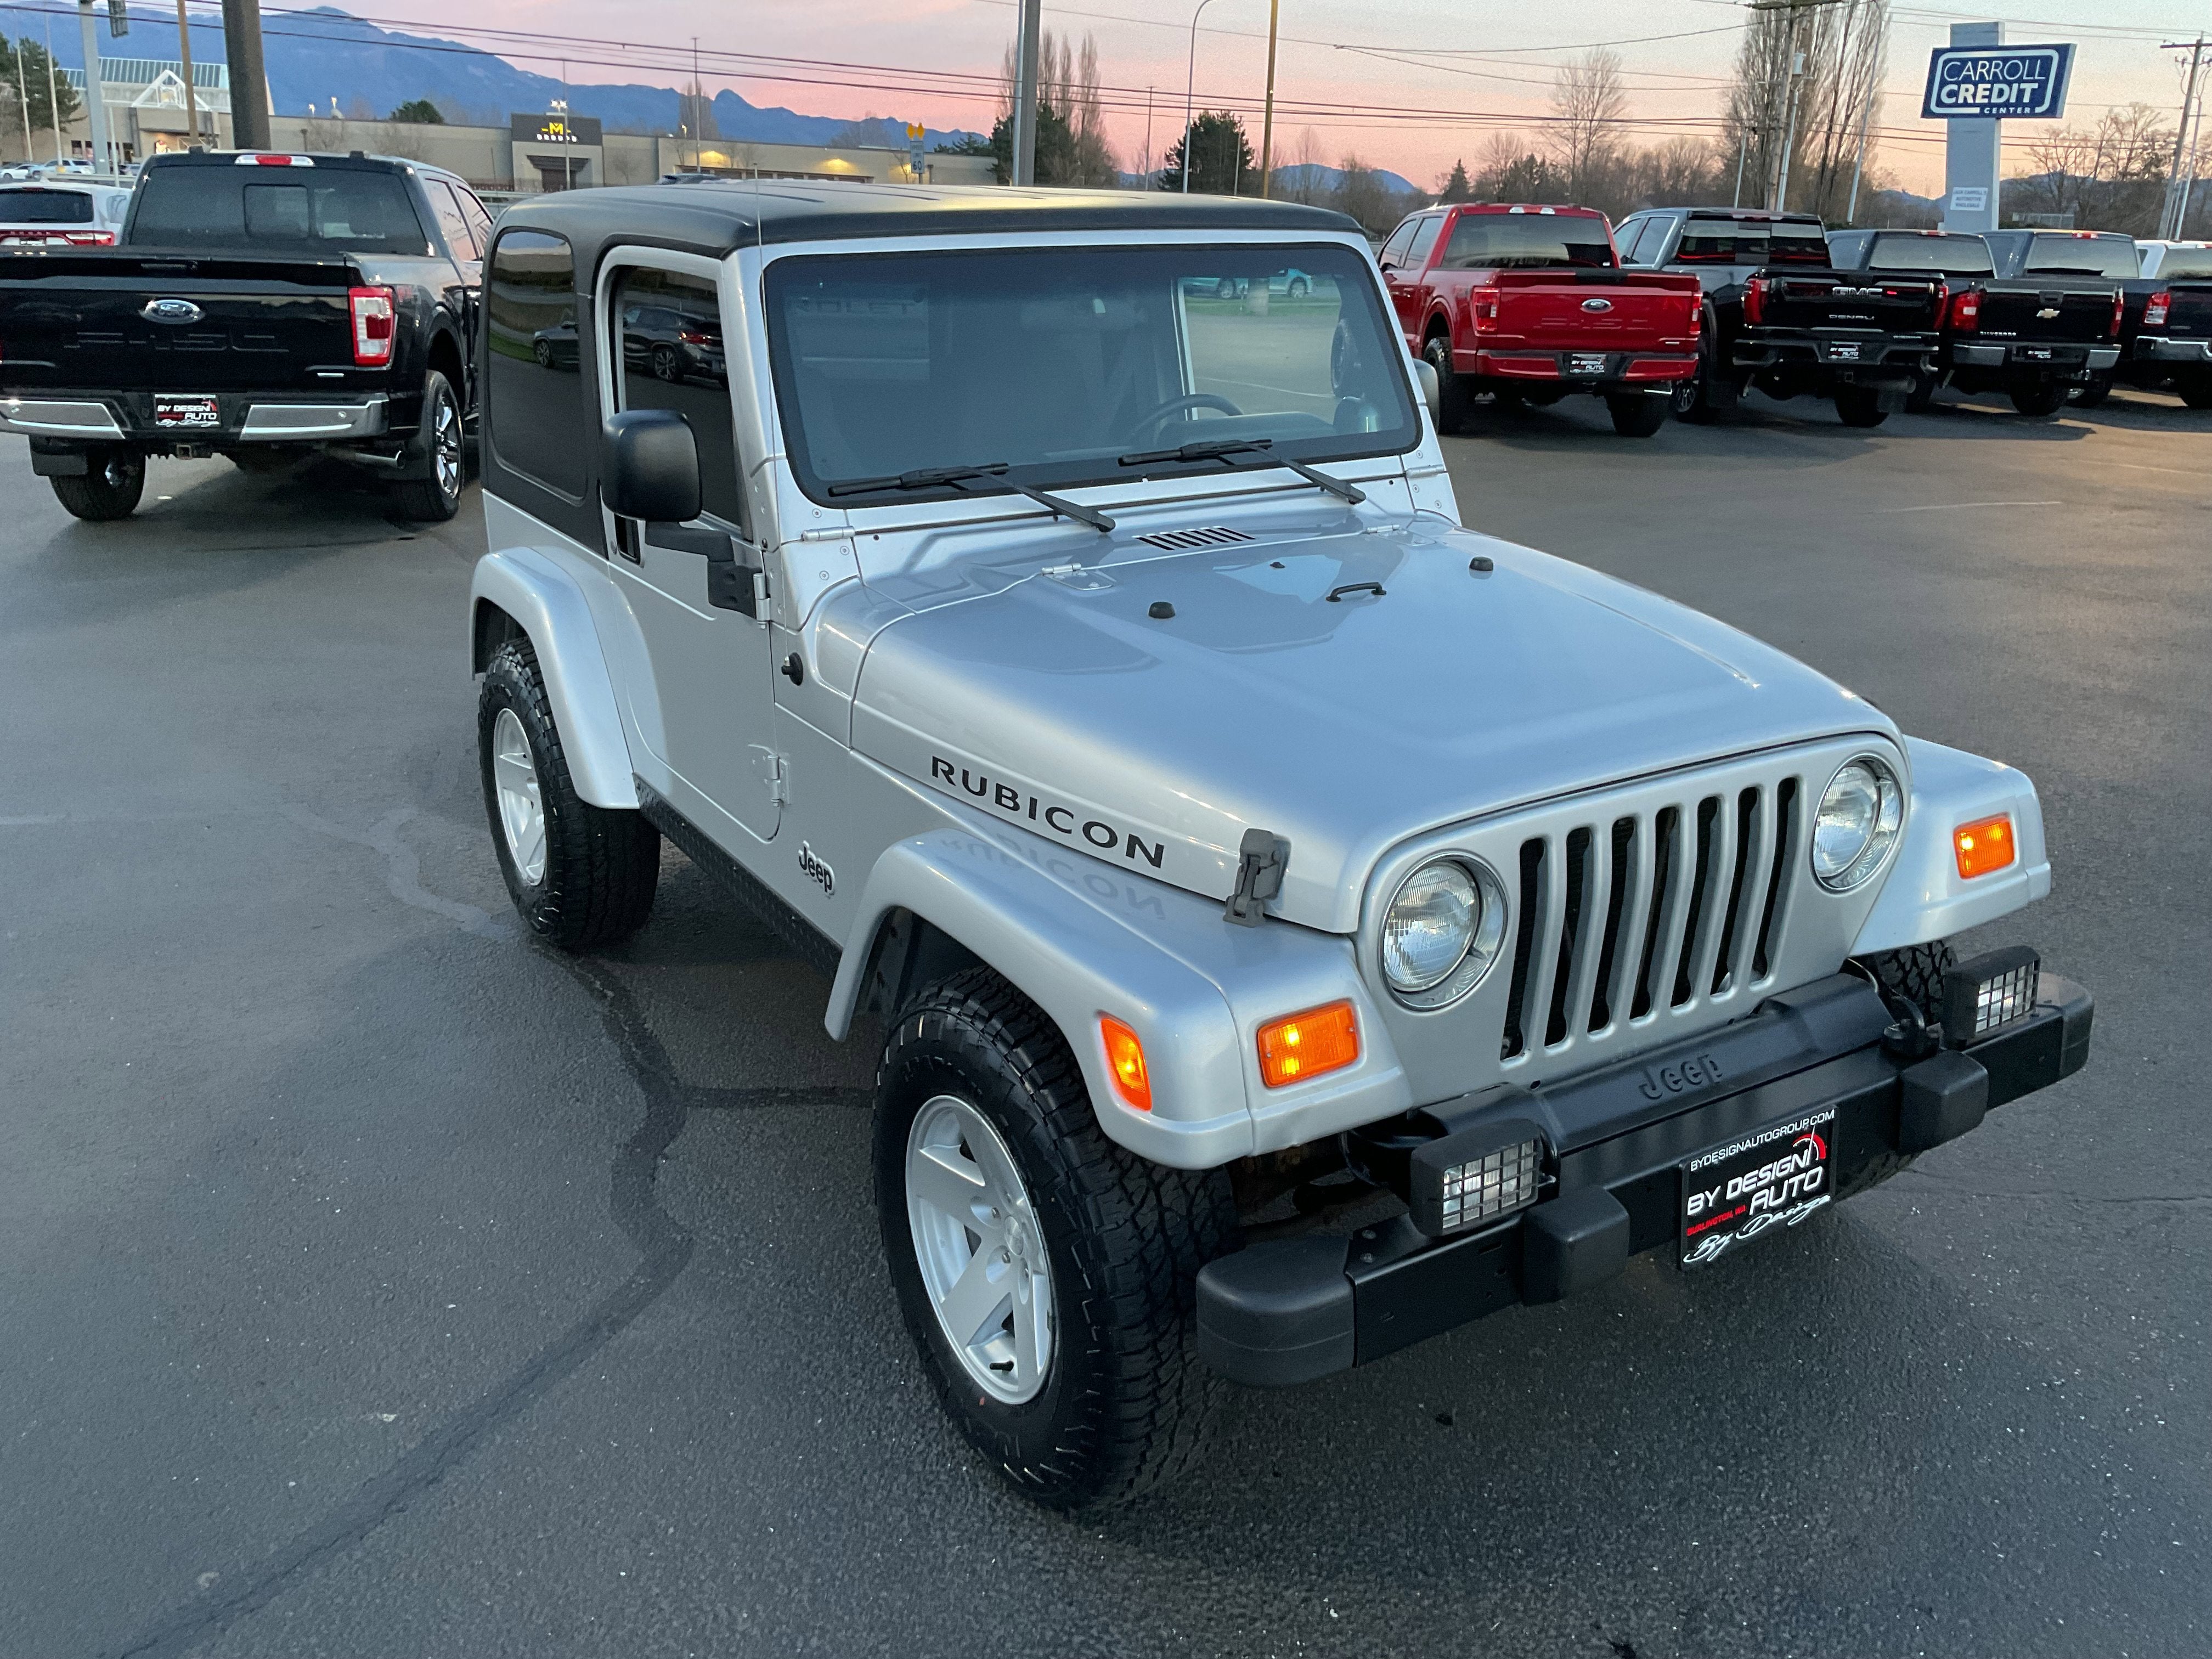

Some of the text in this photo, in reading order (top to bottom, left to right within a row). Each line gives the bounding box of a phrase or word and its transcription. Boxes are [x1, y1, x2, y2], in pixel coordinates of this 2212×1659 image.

[1940, 83, 2039, 104] CREDIT
[1944, 59, 2046, 81] CARROLL
[1832, 286, 1883, 298] GMC
[931, 755, 1165, 869] RUBICON
[798, 843, 834, 895] Jeep
[1638, 1053, 1723, 1100] Jeep
[1690, 1109, 1835, 1172] BYDESIGNAUTOGROUP.COM
[1687, 1149, 1809, 1216] BY DESIGN
[1749, 1166, 1823, 1215] AUTO
[1683, 1195, 1831, 1263] By Design
